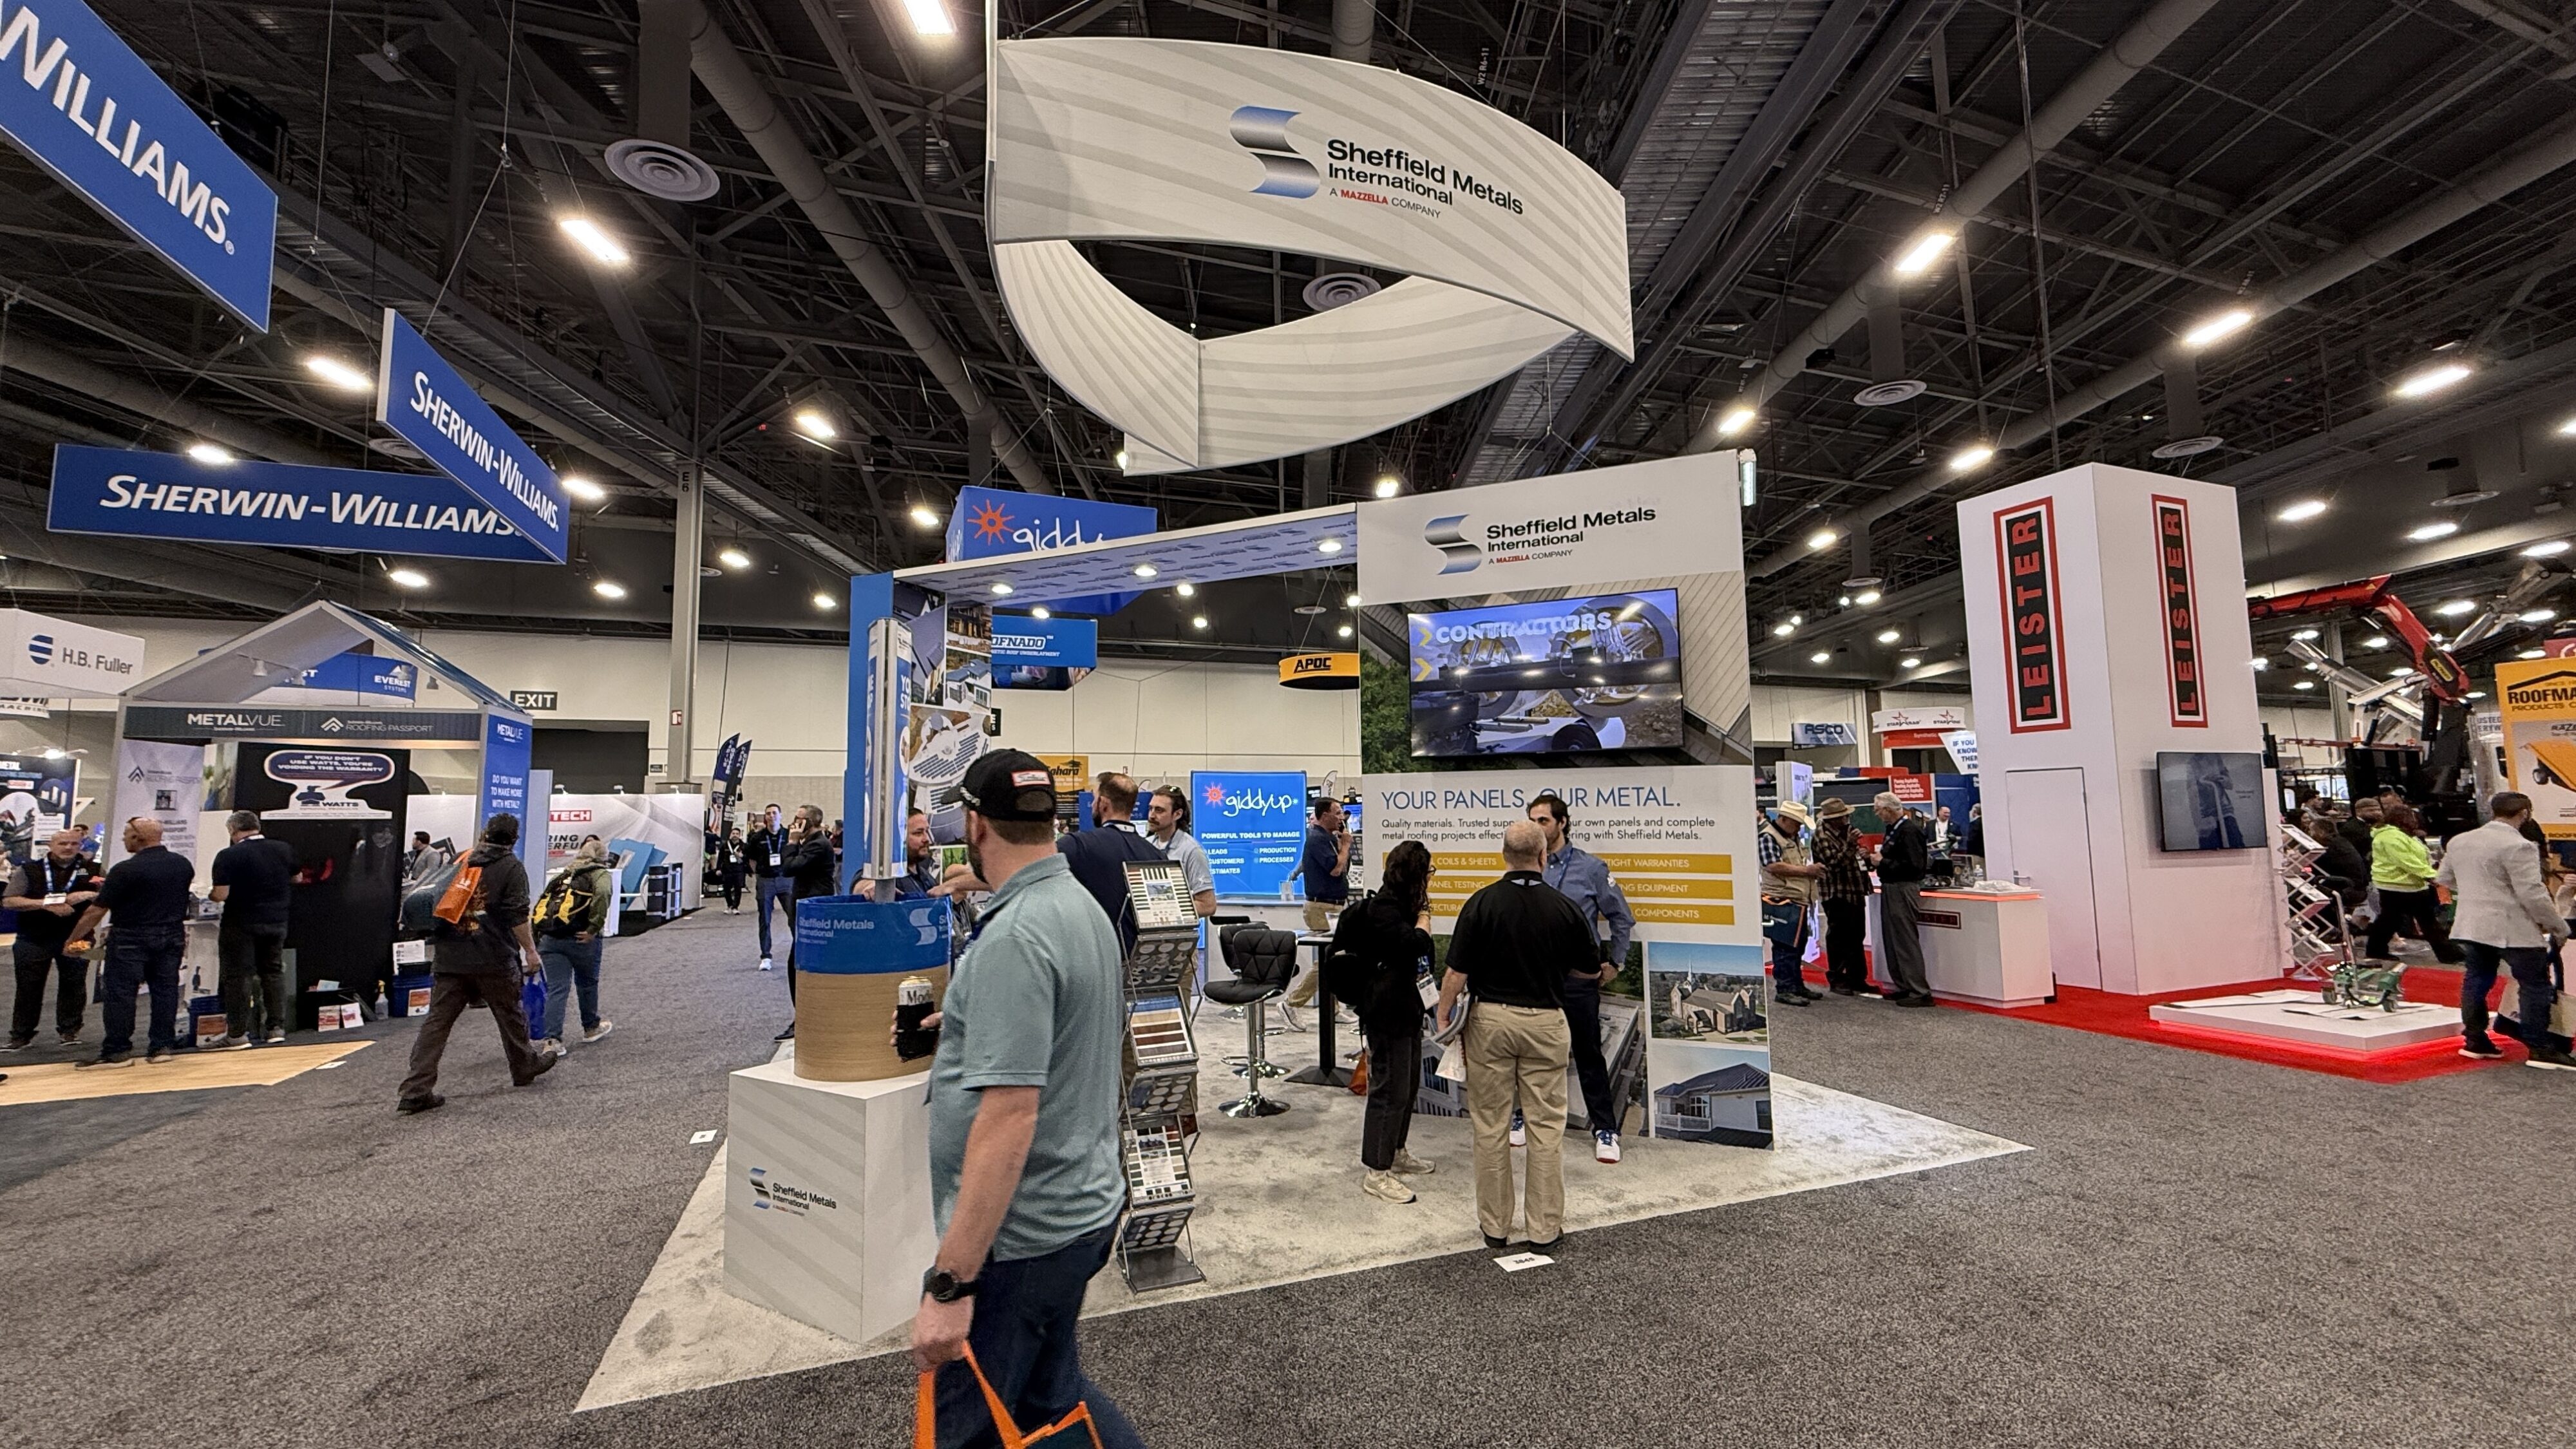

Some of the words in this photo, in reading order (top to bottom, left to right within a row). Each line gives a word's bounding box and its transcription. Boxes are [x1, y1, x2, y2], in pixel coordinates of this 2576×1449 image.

[1327, 138, 1445, 185] Sheffield
[1452, 170, 1524, 214] Metals
[1329, 163, 1452, 205] International
[1330, 187, 1338, 196] A
[1341, 189, 1388, 205] MAZZELLA
[1392, 197, 1441, 218] COMPANY
[1487, 515, 1577, 539] Sheffield
[1584, 507, 1656, 529] Metals
[1488, 531, 1584, 553] International
[1496, 554, 1530, 564] MAZZELLA
[1531, 549, 1573, 560] COMPANY
[2012, 518, 2051, 716] LEISTER
[2163, 513, 2197, 712] LEISTER
[62, 647, 91, 668] H.B.
[95, 655, 133, 674] Fuller
[1294, 658, 1332, 674] APOC
[374, 675, 411, 688] EVEREST
[516, 694, 554, 708] EXIT
[2512, 702, 2564, 712] PRODUCTS
[187, 714, 284, 727] METALVUE
[1223, 788, 1293, 817] giddyup
[1381, 791, 1437, 810] YOUR
[1540, 788, 1588, 807] UR
[1596, 786, 1681, 807] METAL.
[1381, 819, 1411, 829] Quality
[1414, 819, 1453, 828] materials.
[1458, 818, 1490, 828] Trusted
[1609, 817, 1641, 828] panels
[1644, 817, 1663, 827] and
[1667, 817, 1715, 829] complete
[1382, 831, 1405, 840] metal
[1407, 830, 1438, 842] roofing
[1441, 831, 1476, 842] projects
[1594, 830, 1613, 839] with
[1617, 829, 1662, 839] Sheffield
[1665, 830, 1702, 840] Metals.
[1638, 884, 1689, 893] EQUIPMENT
[1634, 909, 1700, 918] COMPONENTS
[799, 917, 831, 929] Sheffield
[833, 919, 875, 930] Metals
[799, 928, 833, 938] International
[773, 1182, 808, 1201] Sheffield
[809, 1192, 837, 1209] Metals
[773, 1194, 810, 1211] International
